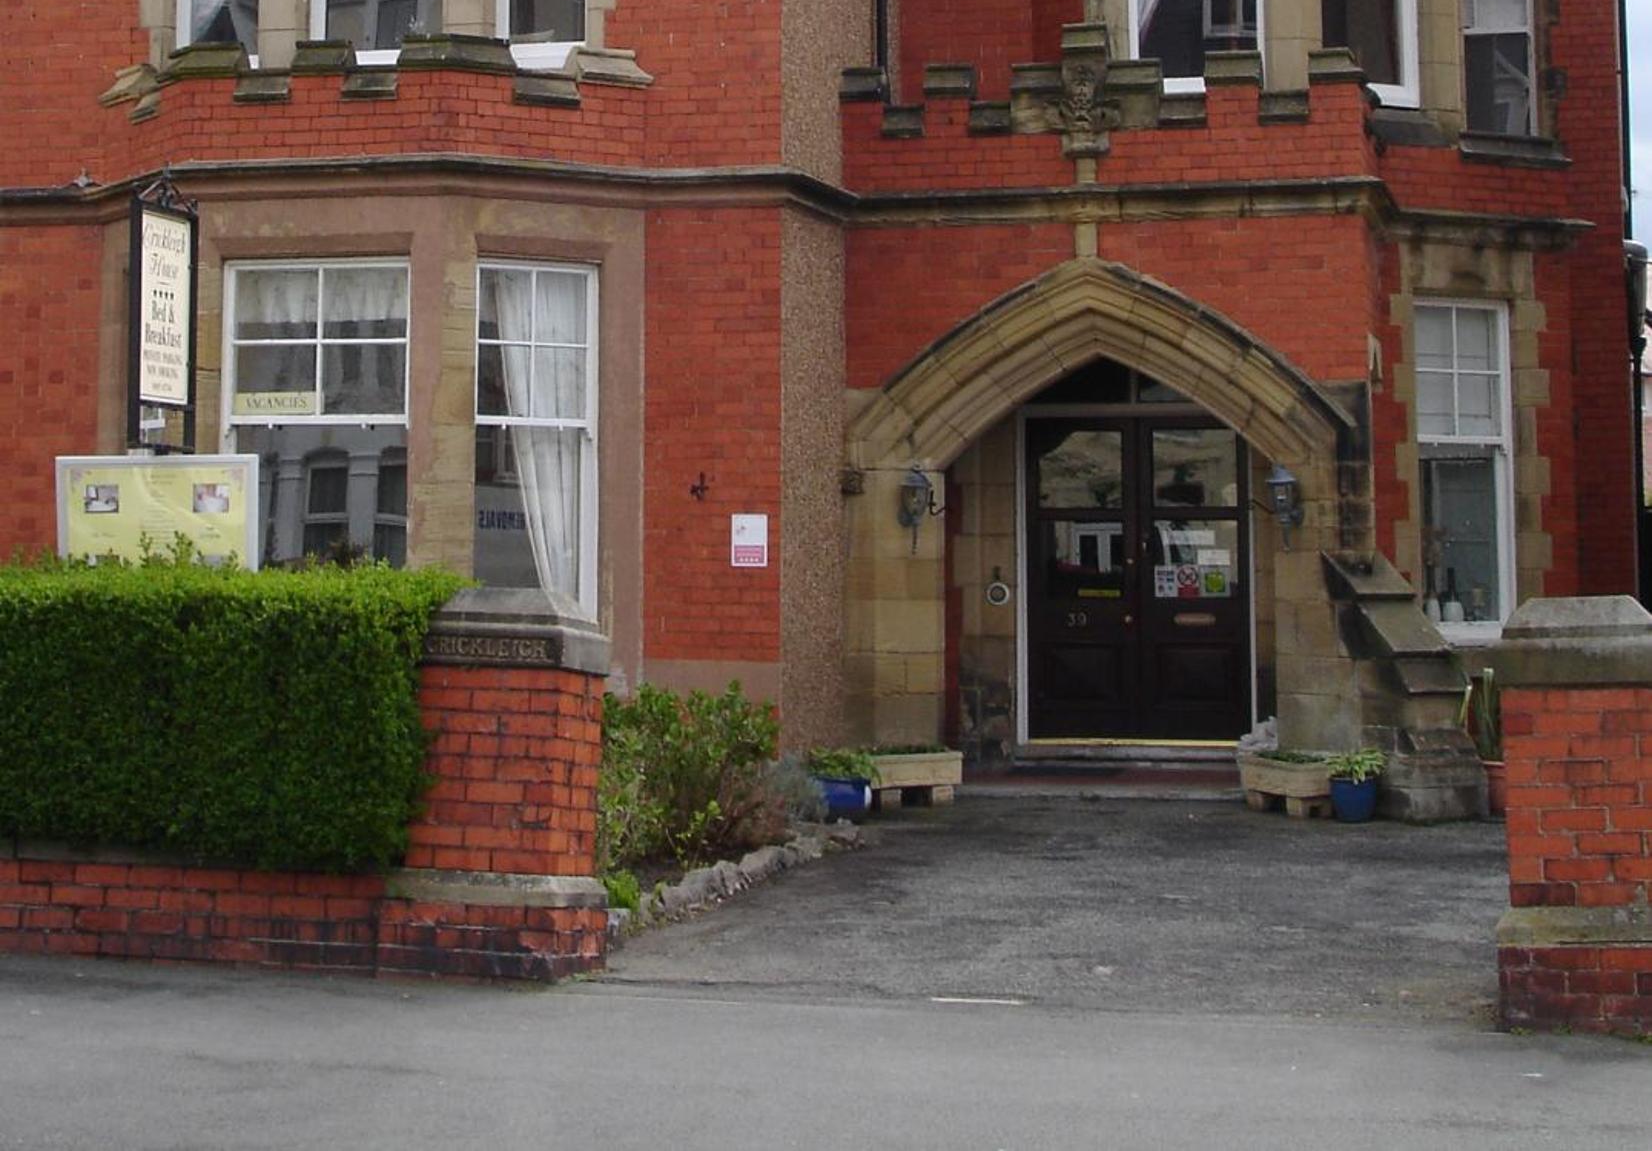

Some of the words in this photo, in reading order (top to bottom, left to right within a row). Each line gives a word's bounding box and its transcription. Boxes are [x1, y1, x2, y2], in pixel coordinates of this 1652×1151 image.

[151, 300, 166, 323] Bed
[145, 322, 182, 348] Breakfast
[245, 396, 308, 409] VACANCIES
[1067, 612, 1087, 628] 39
[425, 634, 547, 659] CRICKLEIGH
